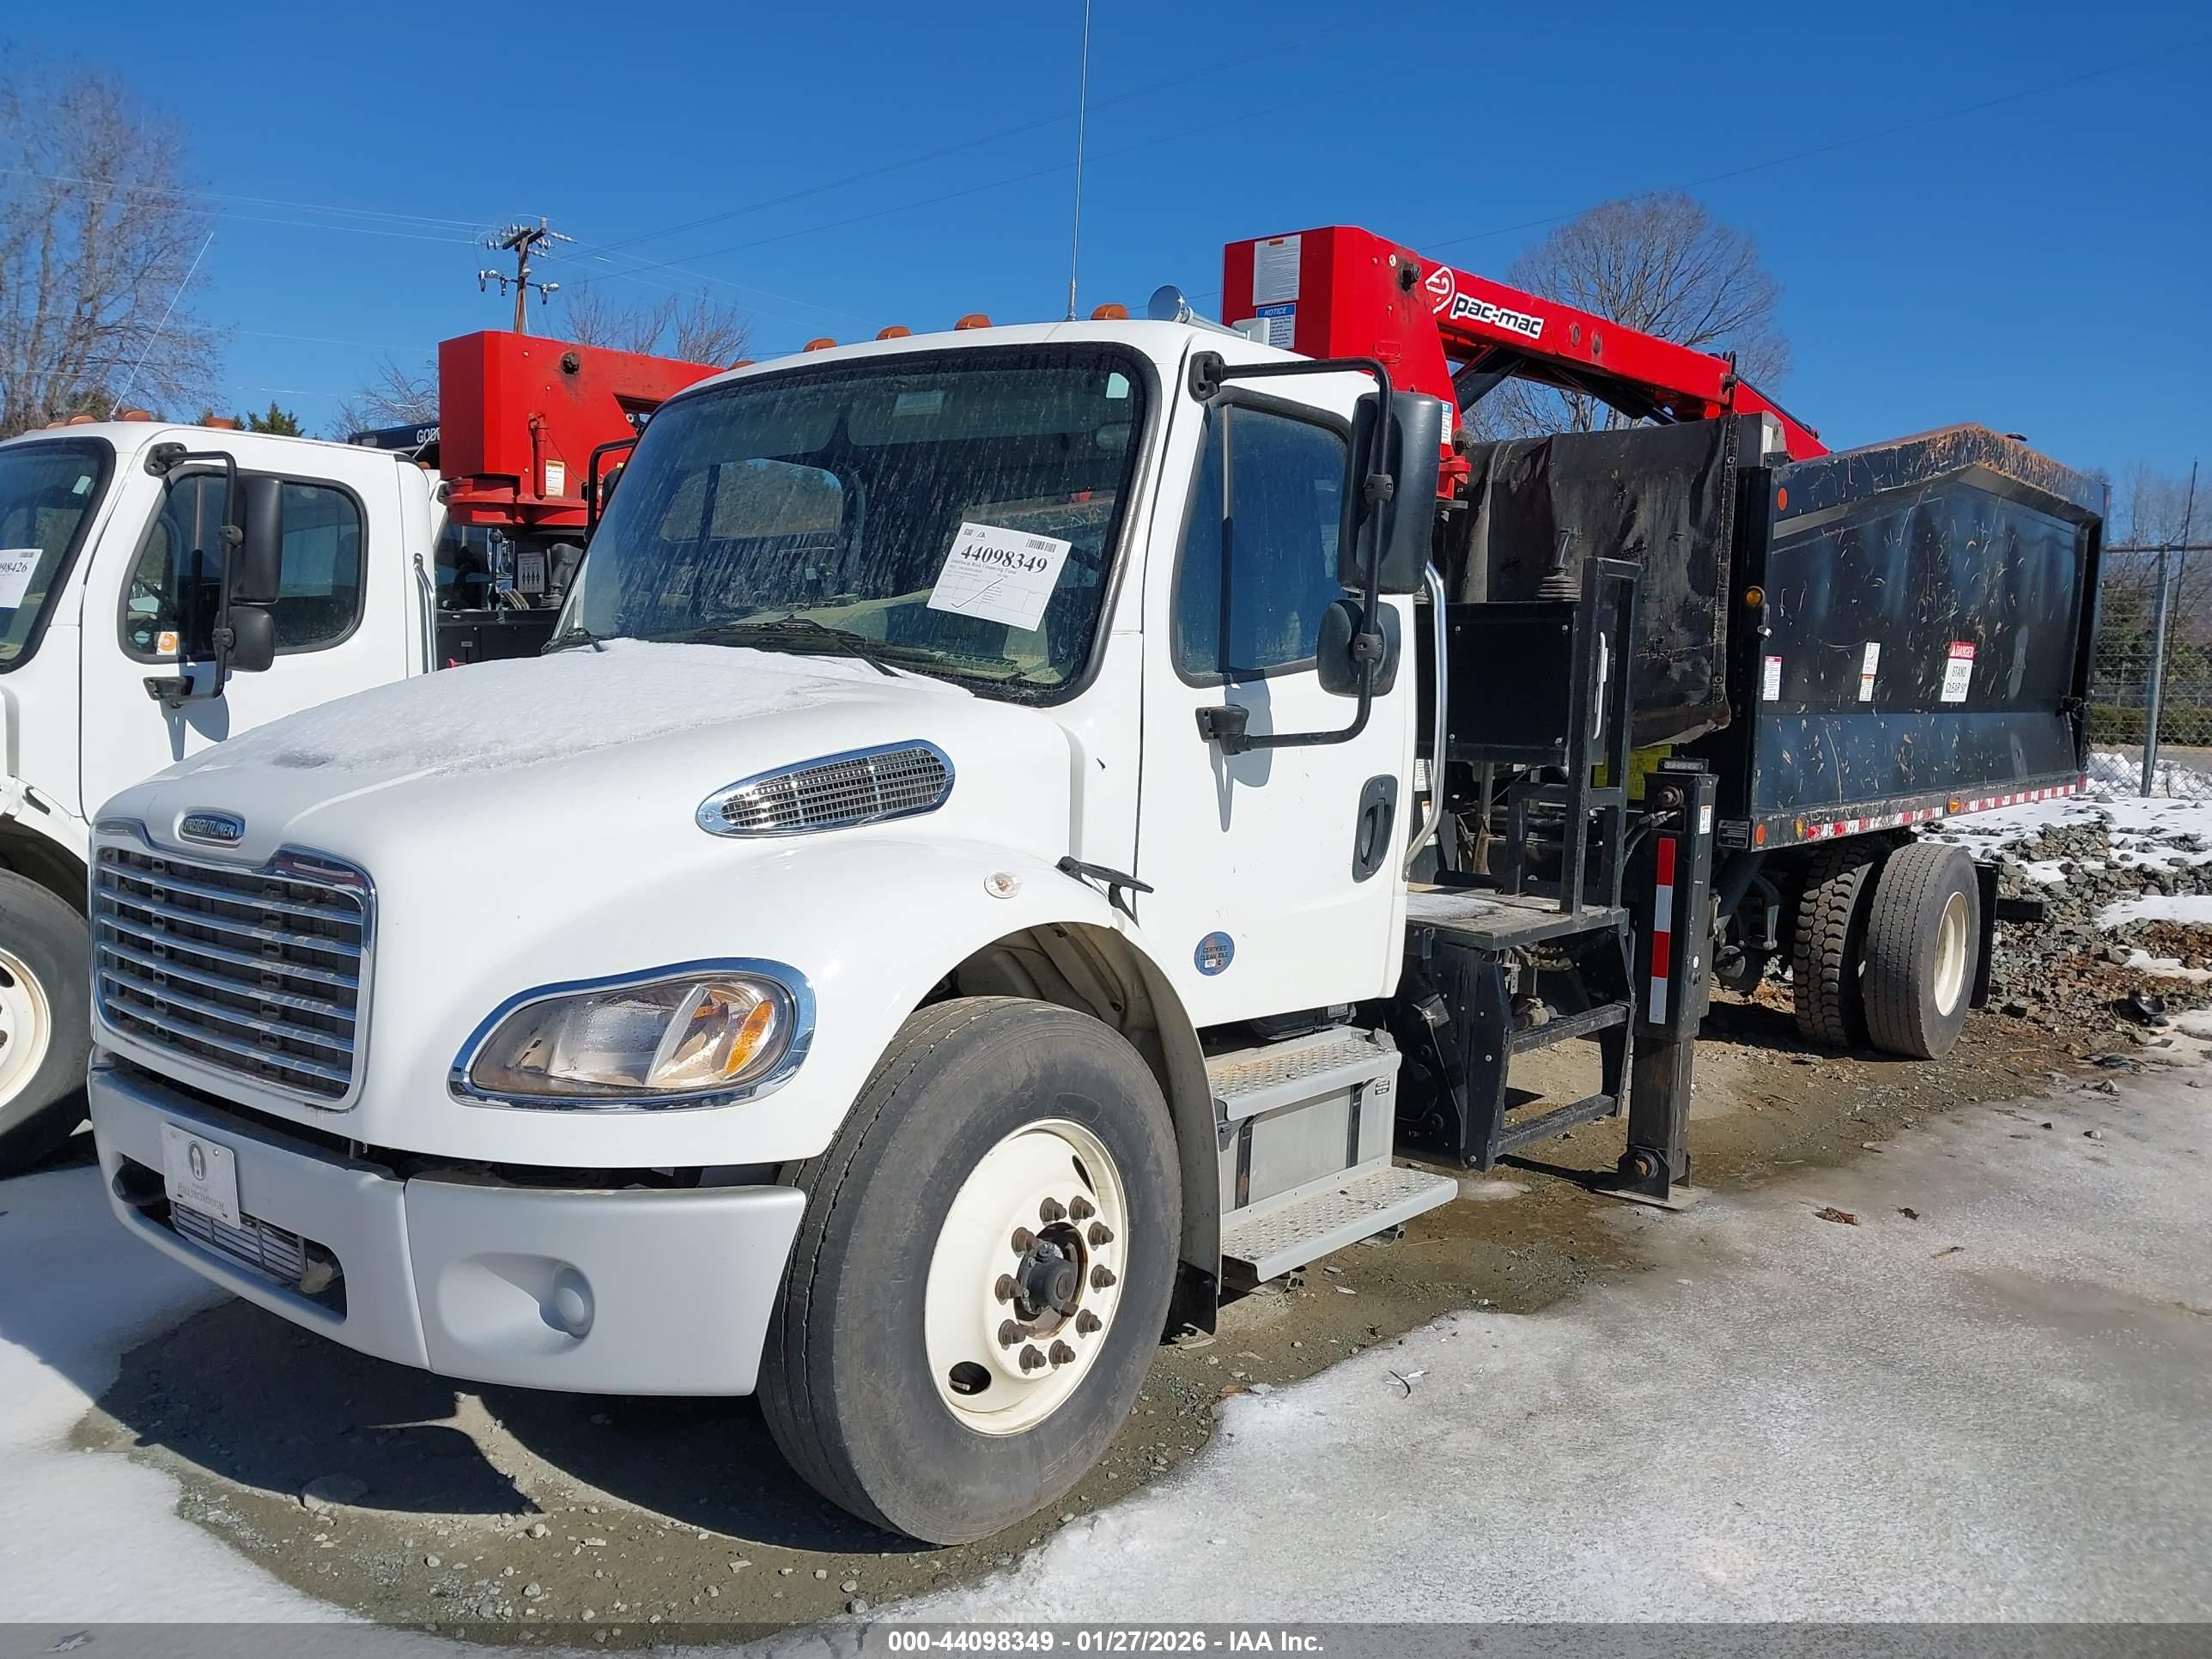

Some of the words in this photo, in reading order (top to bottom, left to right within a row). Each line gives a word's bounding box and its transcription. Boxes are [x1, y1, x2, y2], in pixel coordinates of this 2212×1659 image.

[1264, 307, 1288, 317] NOTICE
[1451, 295, 1543, 337] pac-mac
[961, 544, 1048, 574] 44098349
[0, 562, 29, 574] 98426
[1955, 644, 1975, 659] DANGER
[1951, 665, 1967, 678] STAND
[1945, 682, 1961, 694] CLEAR
[183, 817, 236, 838] FREIGHTLINER
[1202, 945, 1228, 954] CERTIFIED
